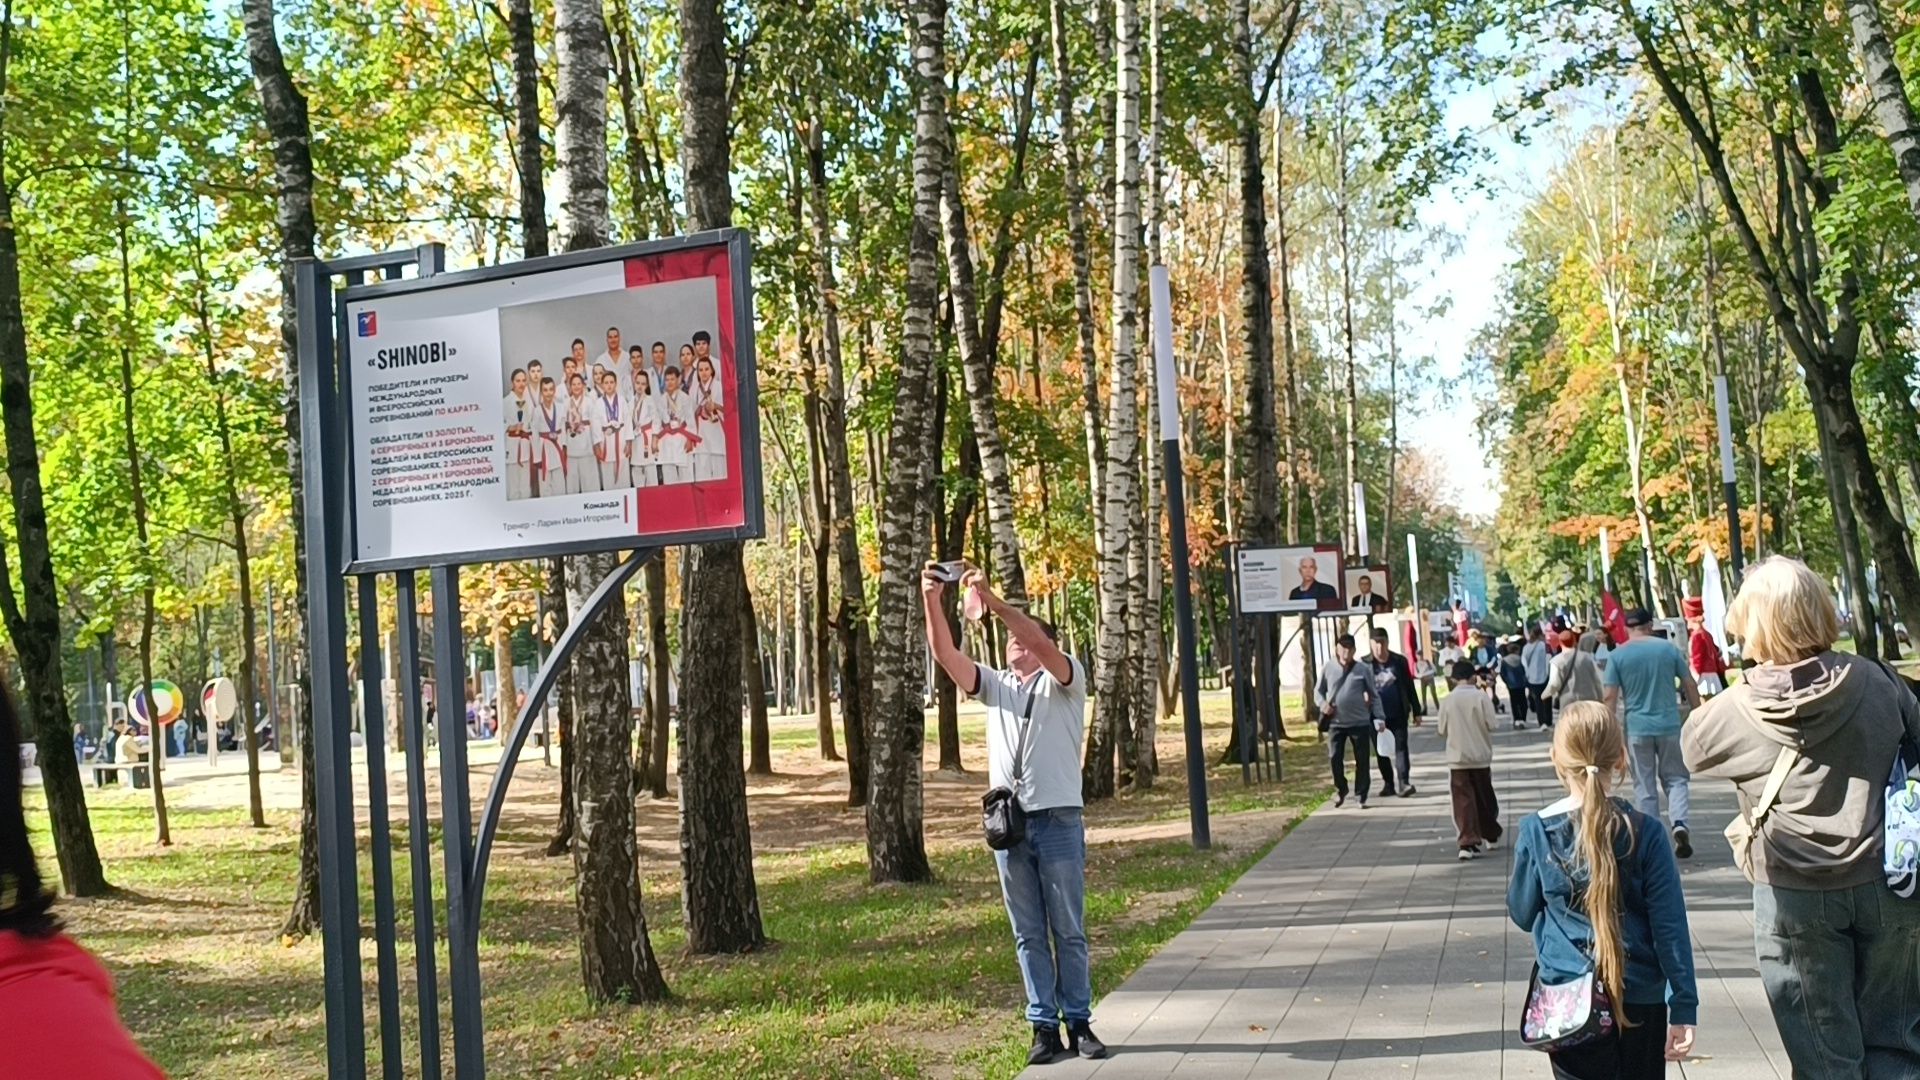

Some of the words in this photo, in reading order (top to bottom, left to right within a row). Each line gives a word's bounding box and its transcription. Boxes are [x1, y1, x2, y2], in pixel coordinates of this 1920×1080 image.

[367, 341, 457, 370] «SHINOBI»
[368, 379, 421, 392] ПОБЕДИТЕЛИ
[430, 373, 469, 385] ПРИЗЕРЫ
[369, 388, 443, 402] МЕЖДУНАРОДНЫХ
[376, 398, 445, 412] ВСЕРОССИЙСКИХ
[369, 408, 434, 424] СОРЕВНОВАНИЙ
[435, 407, 446, 416] ПО
[370, 433, 424, 444] ОБЛАДАТЕЛИ
[377, 442, 429, 454] СЕРЕБРЯНЫХ
[445, 434, 495, 446] БРОНЗОВЫХ
[371, 454, 409, 465] МЕДАЛЕЙ
[423, 445, 494, 459] ВСЕРОССИЙСКИХ
[378, 474, 430, 486] СЕРЕБРЯНЫХ
[445, 465, 494, 478] БРОНЗОВОЙ
[372, 485, 410, 497] МЕДАЛЕЙ
[424, 476, 500, 490] МЕЖДУНАРОДНЫХ
[583, 500, 620, 510] Команда
[503, 522, 530, 531] Тренер
[537, 519, 561, 528] Ларин
[562, 517, 582, 525] Иван
[583, 513, 620, 524] Игоревич
